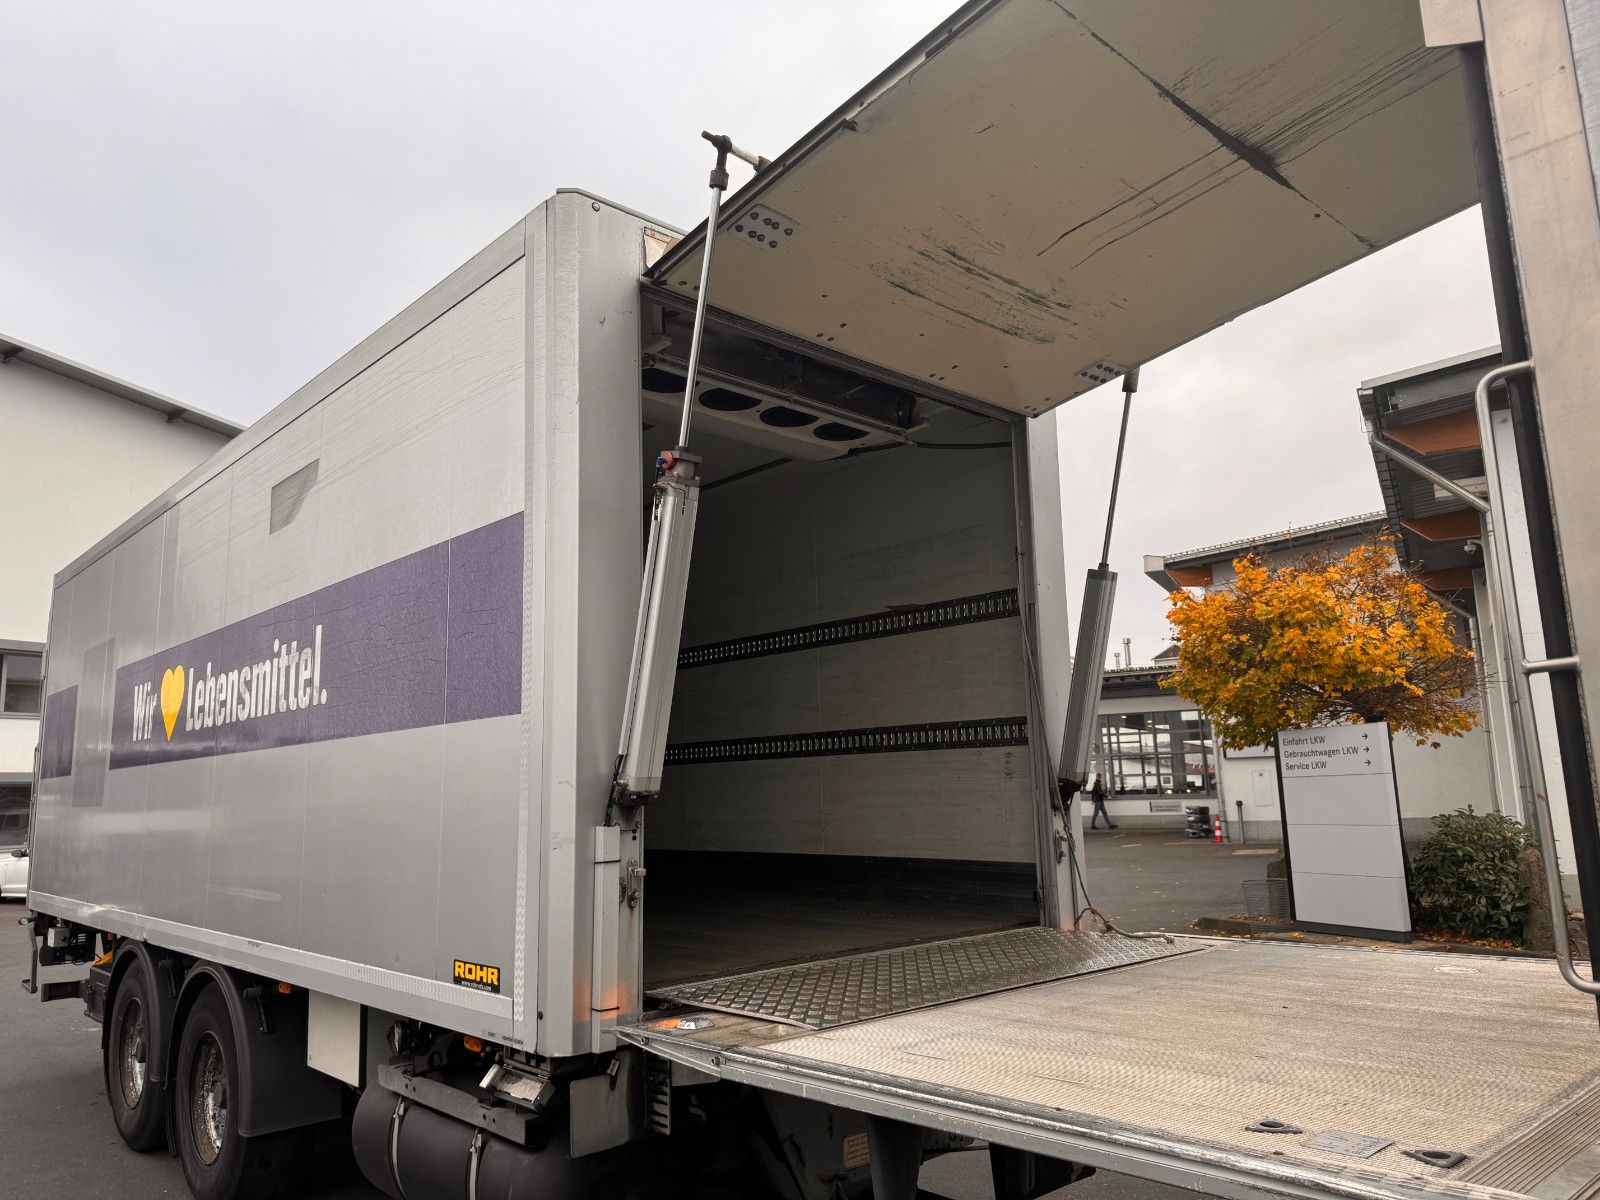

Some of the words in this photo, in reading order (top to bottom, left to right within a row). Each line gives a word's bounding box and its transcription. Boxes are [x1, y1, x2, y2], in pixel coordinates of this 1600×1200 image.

[133, 681, 157, 742] Wir
[185, 624, 328, 732] Lebensmittel.
[1282, 738, 1309, 746] Einfahrt
[1310, 736, 1326, 744] LKW
[1284, 749, 1340, 758] Gebrauchtwagen
[1342, 746, 1359, 755] LKW
[1285, 762, 1310, 770] Service
[1311, 761, 1327, 769] LKW
[455, 961, 498, 985] ROHR
